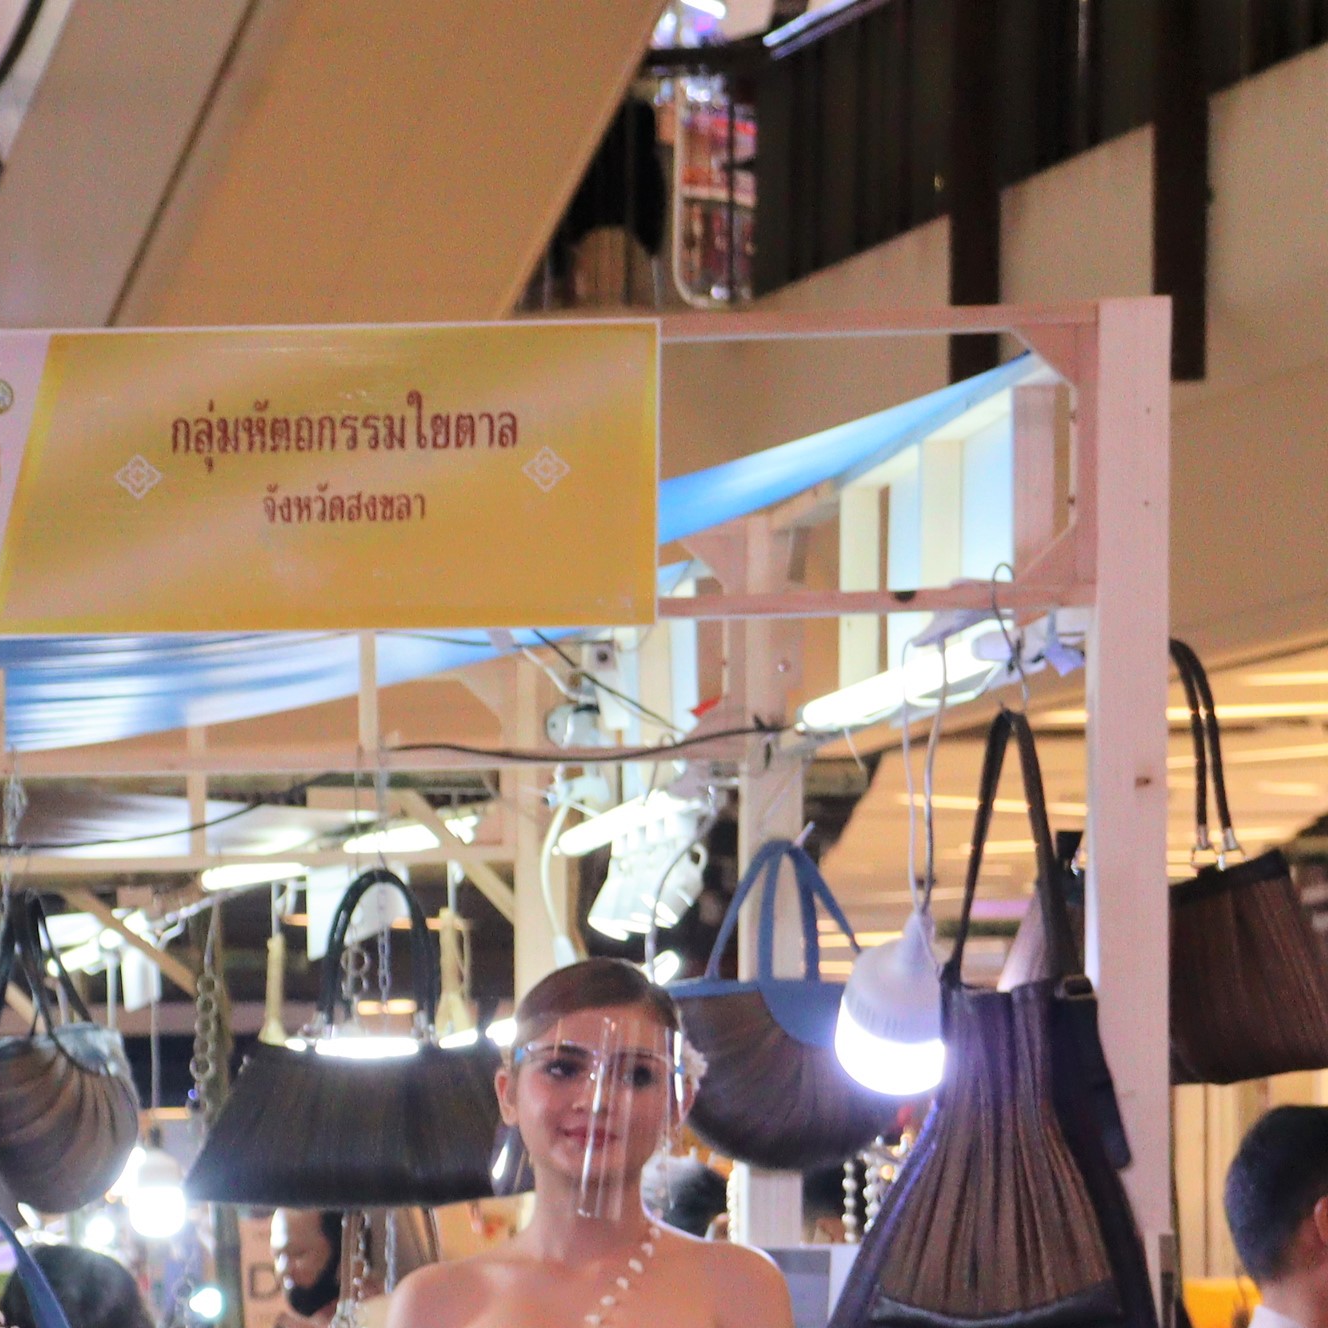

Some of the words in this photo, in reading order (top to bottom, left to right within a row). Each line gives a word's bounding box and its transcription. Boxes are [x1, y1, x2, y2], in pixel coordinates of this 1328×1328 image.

[170, 389, 519, 473] กลุ่มหัตถกรรมใยตาล
[263, 483, 427, 524] จังหวัดสงขลา
